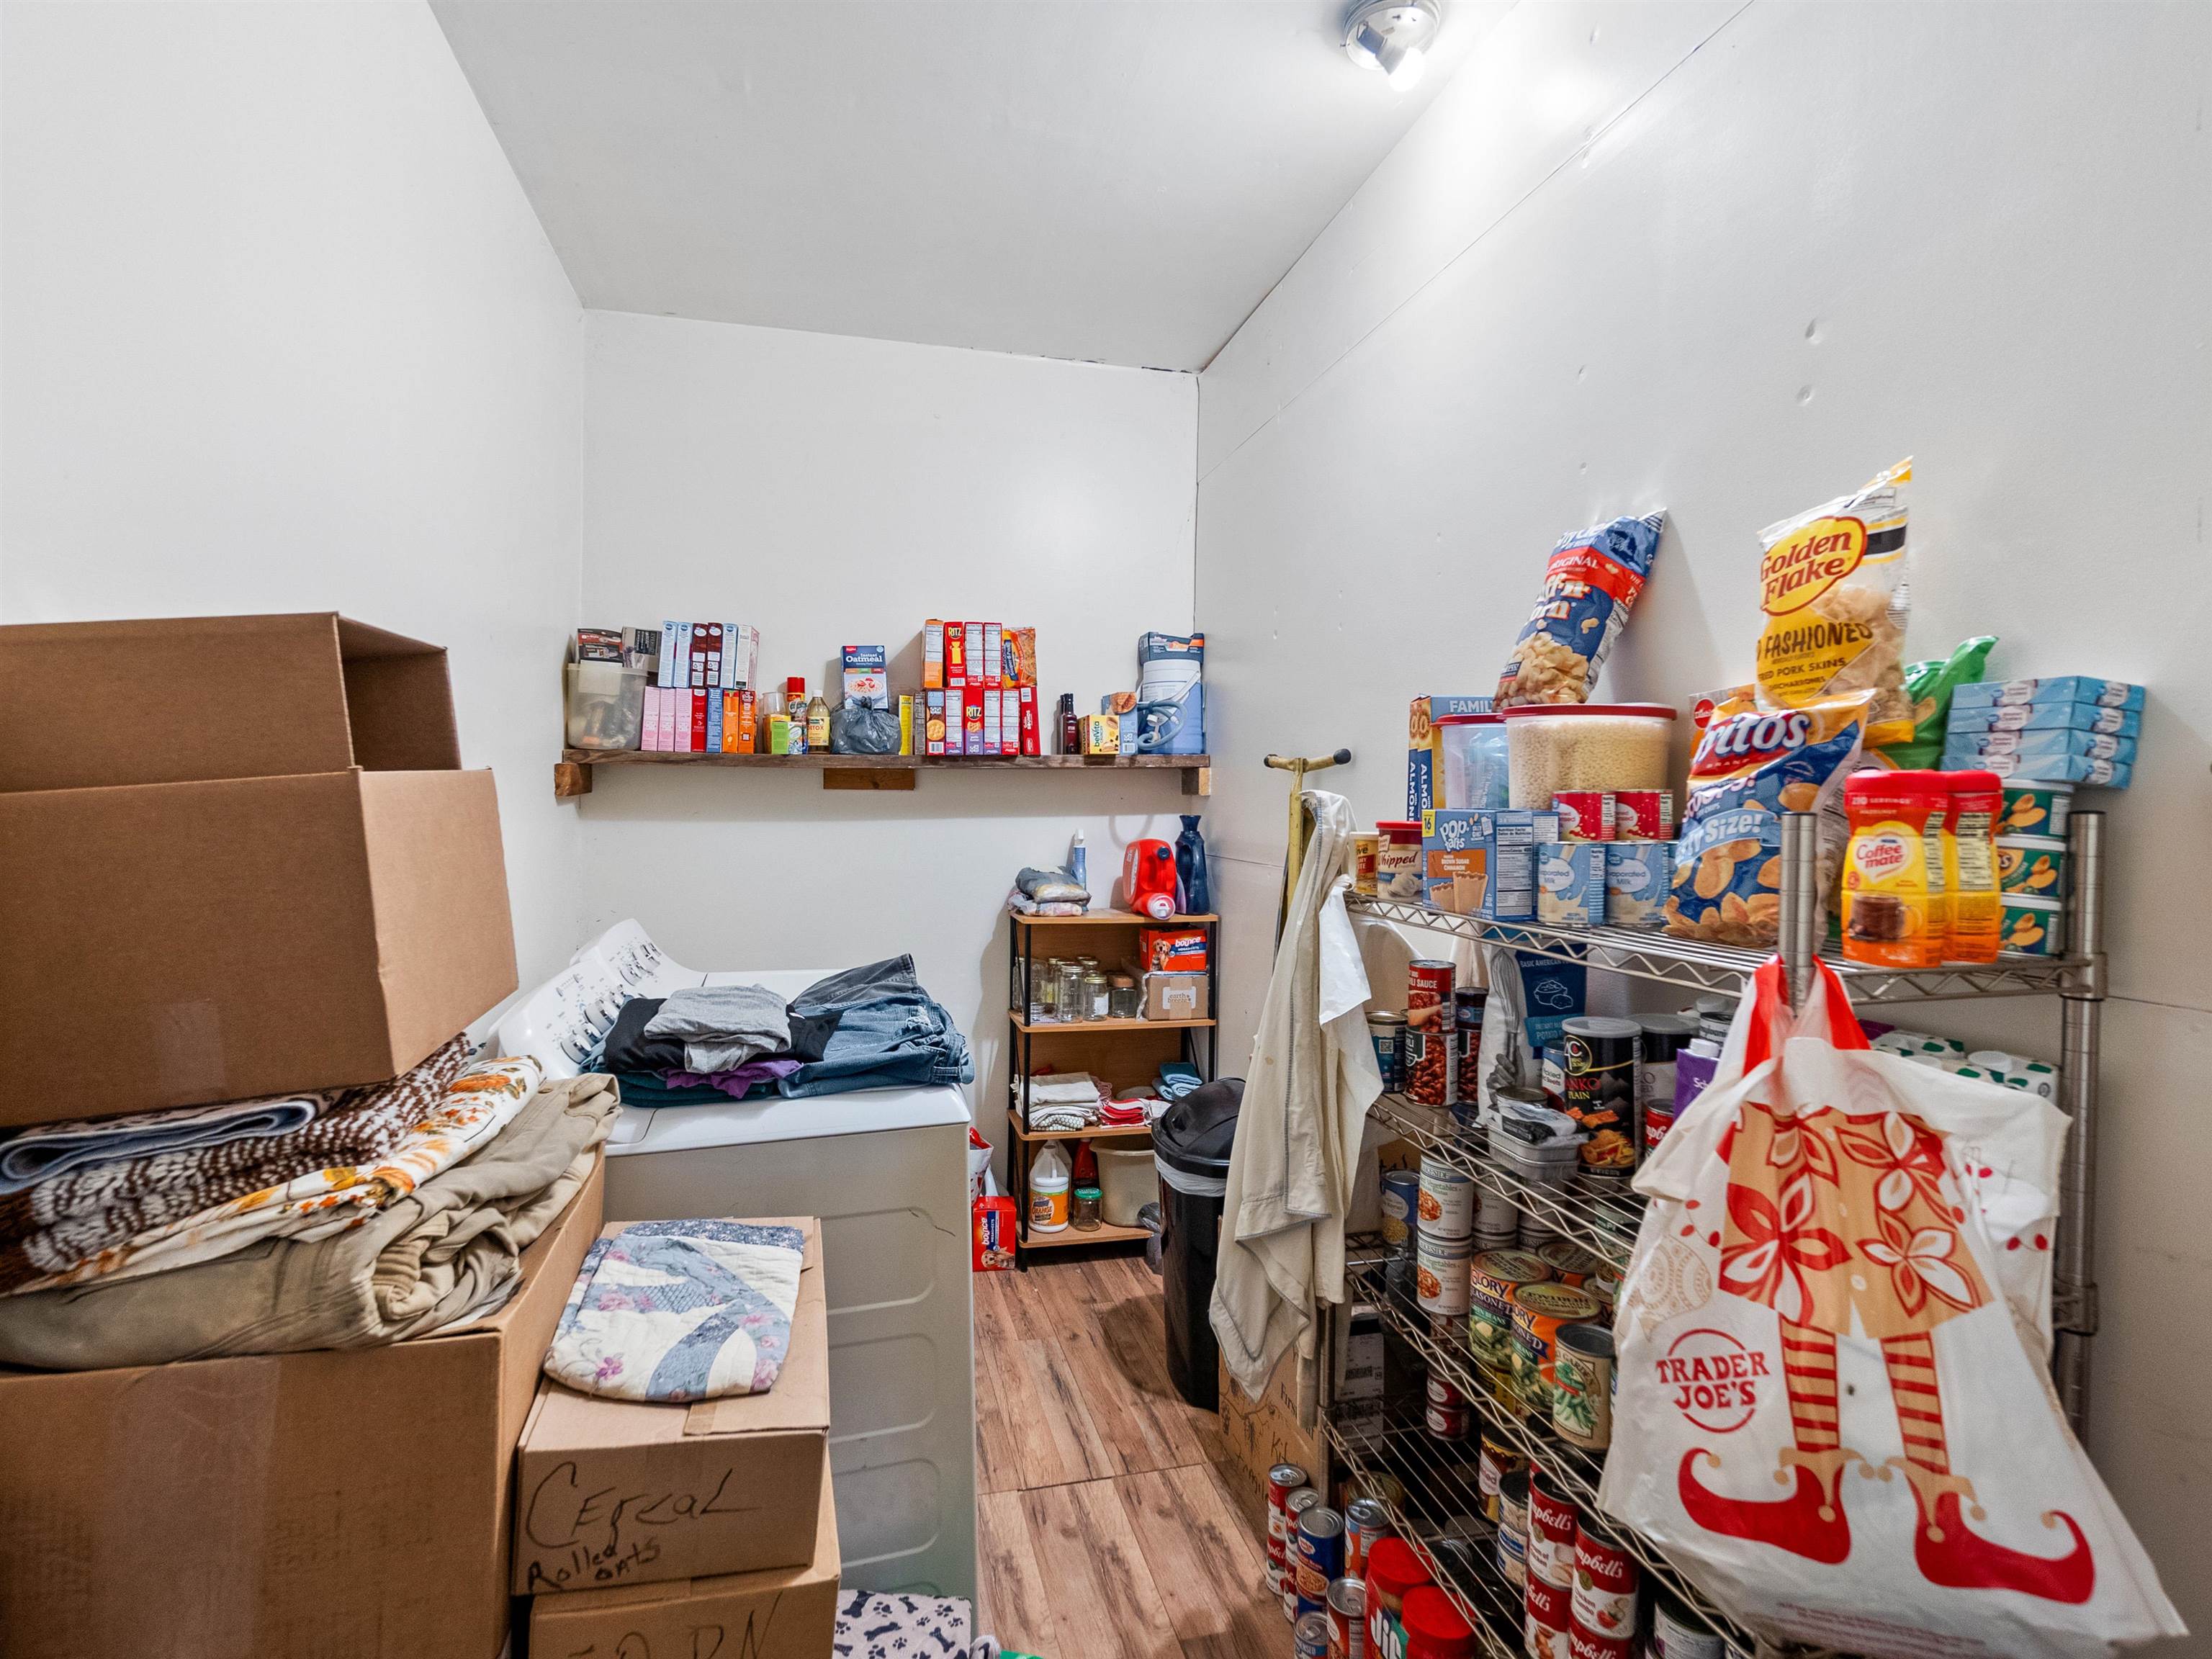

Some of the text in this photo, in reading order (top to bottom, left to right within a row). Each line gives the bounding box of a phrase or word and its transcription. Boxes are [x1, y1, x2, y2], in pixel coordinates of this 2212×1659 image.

[1761, 530, 1851, 582] Golden
[1764, 557, 1845, 606] Flake
[948, 626, 962, 637] RITZ
[1765, 622, 1873, 659] FASHIONED
[1776, 664, 1805, 678] PORK
[1808, 657, 1847, 672] SKINS
[966, 706, 982, 718] RITZ
[1449, 700, 1493, 713] FAMIL
[1091, 721, 1100, 747] belVita
[1692, 711, 1811, 765] ritos
[1408, 762, 1416, 822] ALMON
[1424, 817, 1431, 830] 16
[1704, 814, 1763, 843] Size!
[1856, 844, 1902, 860] Coffee
[1866, 854, 1905, 868] mate
[1174, 936, 1202, 948] bounce
[1416, 978, 1438, 989] SAUCE
[1565, 1077, 1601, 1091] ANKO
[981, 1216, 990, 1246] bounce
[1656, 1352, 1771, 1384] TRADER
[1673, 1380, 1756, 1410] JOE'S
[528, 1543, 617, 1592] Rolled
